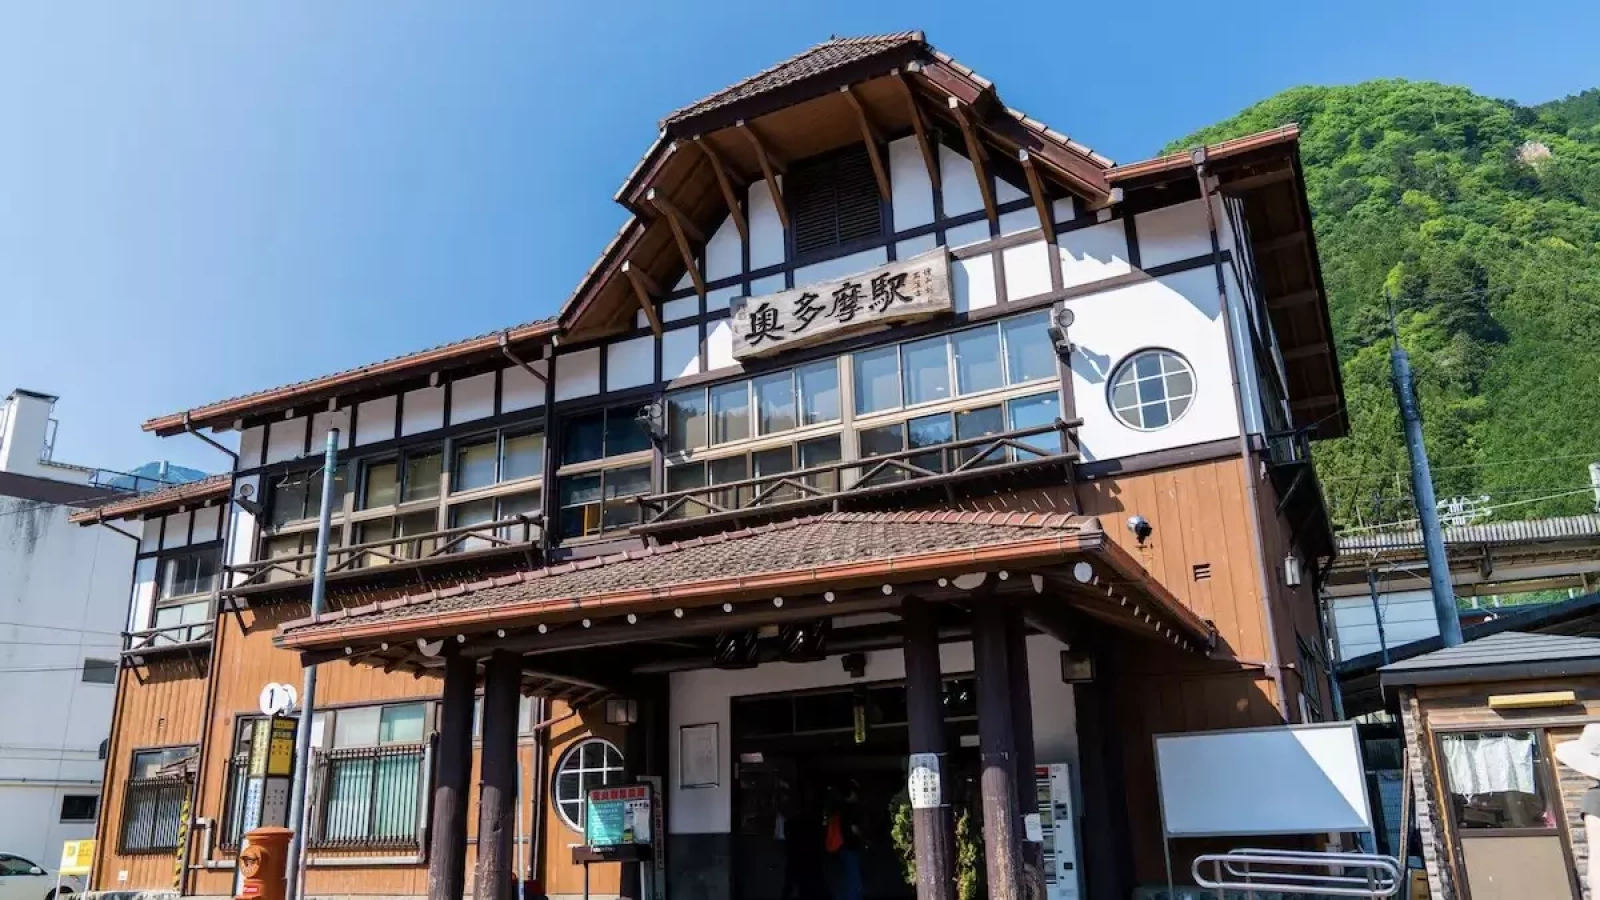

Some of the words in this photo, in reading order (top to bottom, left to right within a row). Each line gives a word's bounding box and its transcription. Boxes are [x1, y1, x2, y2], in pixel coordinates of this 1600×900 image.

[744, 271, 913, 345] 奥多摩駅
[269, 688, 275, 708] 1
